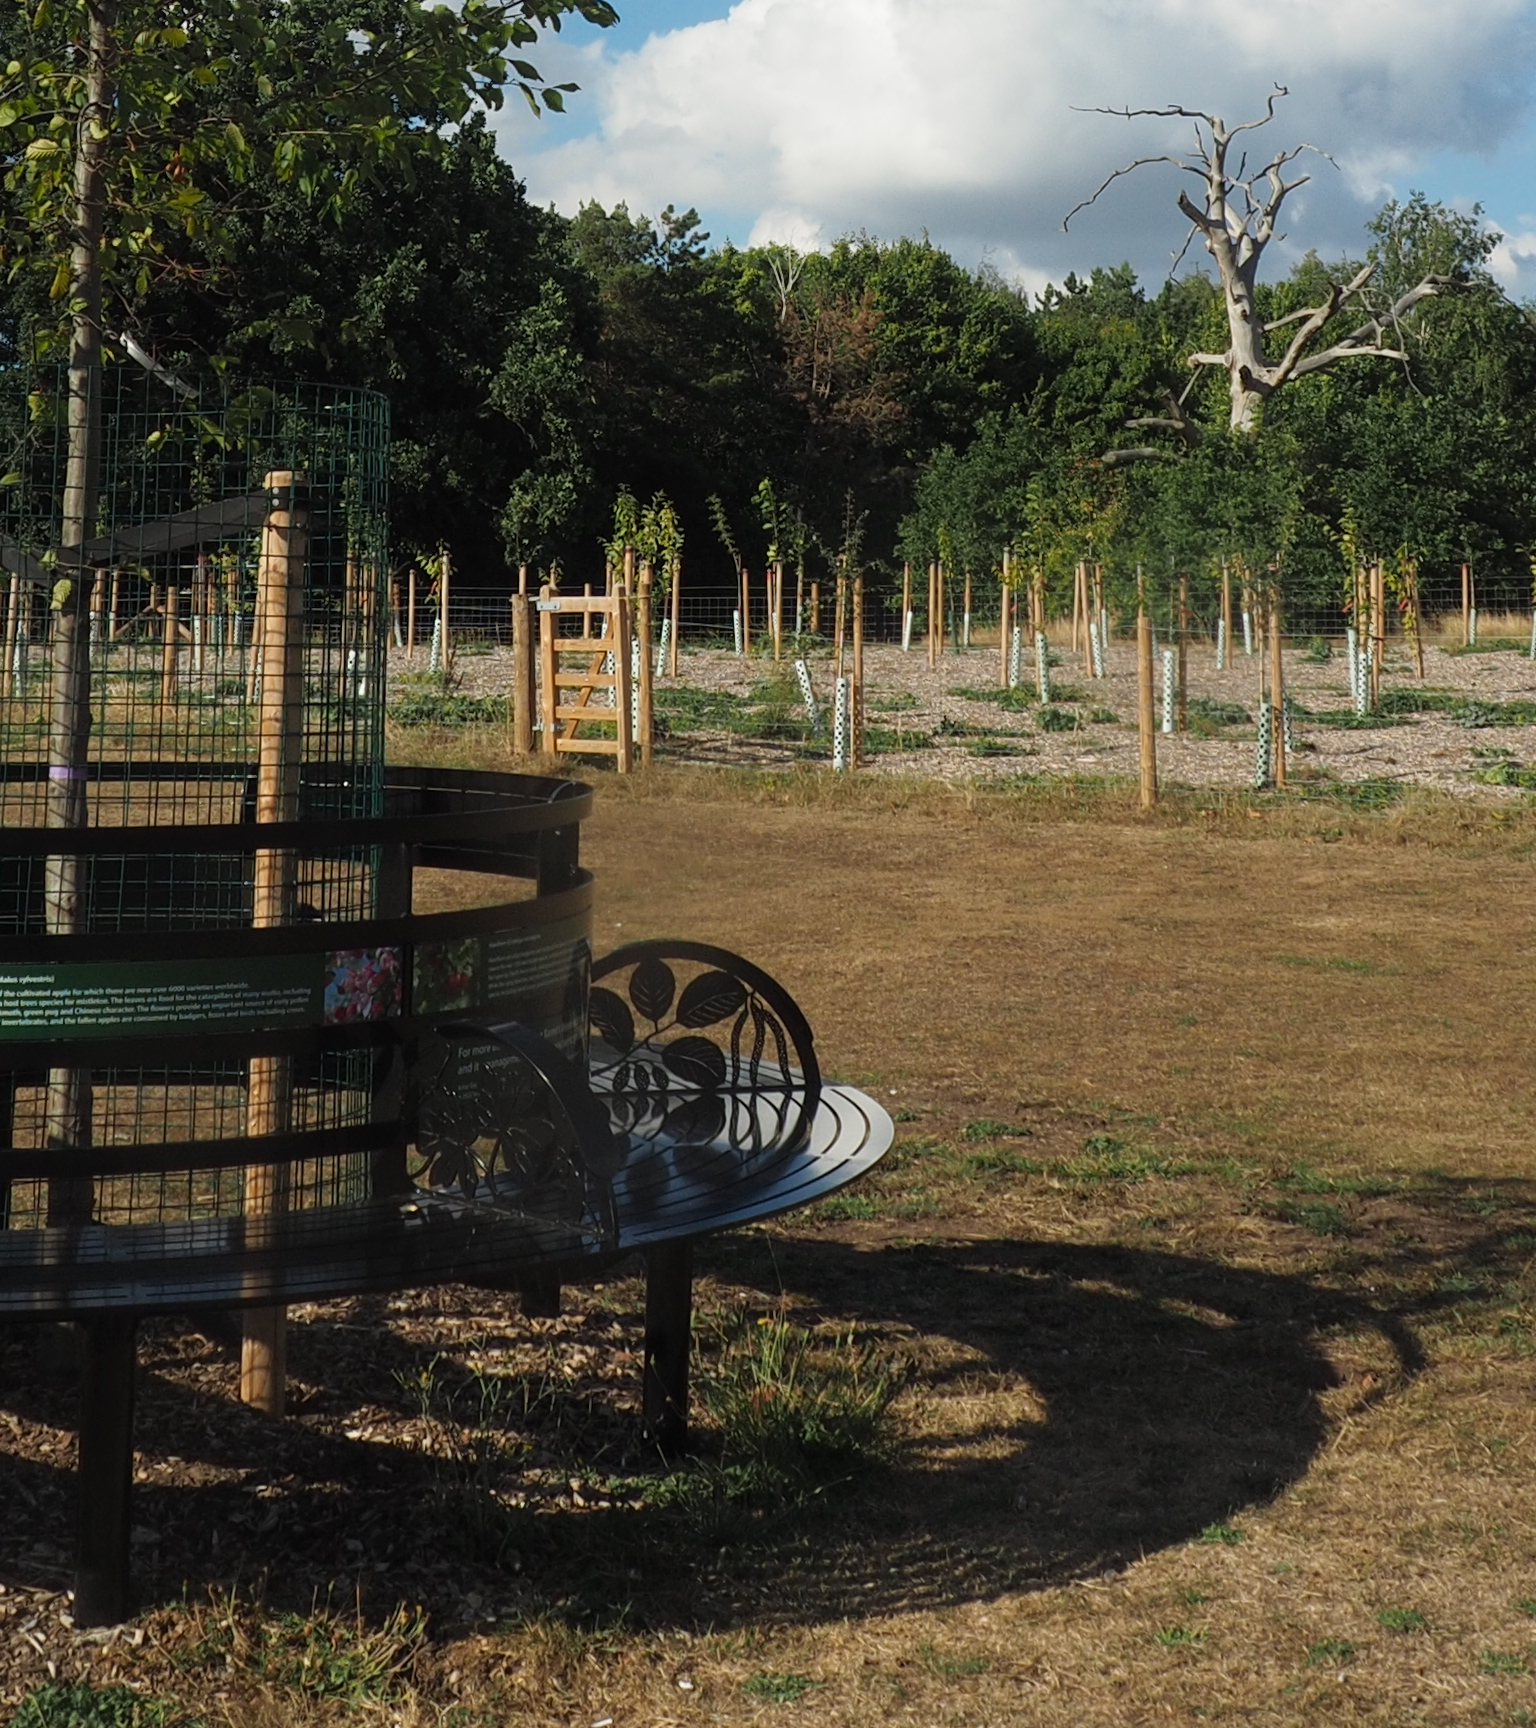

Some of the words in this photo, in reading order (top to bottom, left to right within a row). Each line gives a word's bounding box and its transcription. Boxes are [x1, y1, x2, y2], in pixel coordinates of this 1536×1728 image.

[198, 992, 233, 1000] caterpillars
[458, 1047, 471, 1058] For
[472, 1045, 491, 1055] more
[457, 1061, 472, 1074] and
